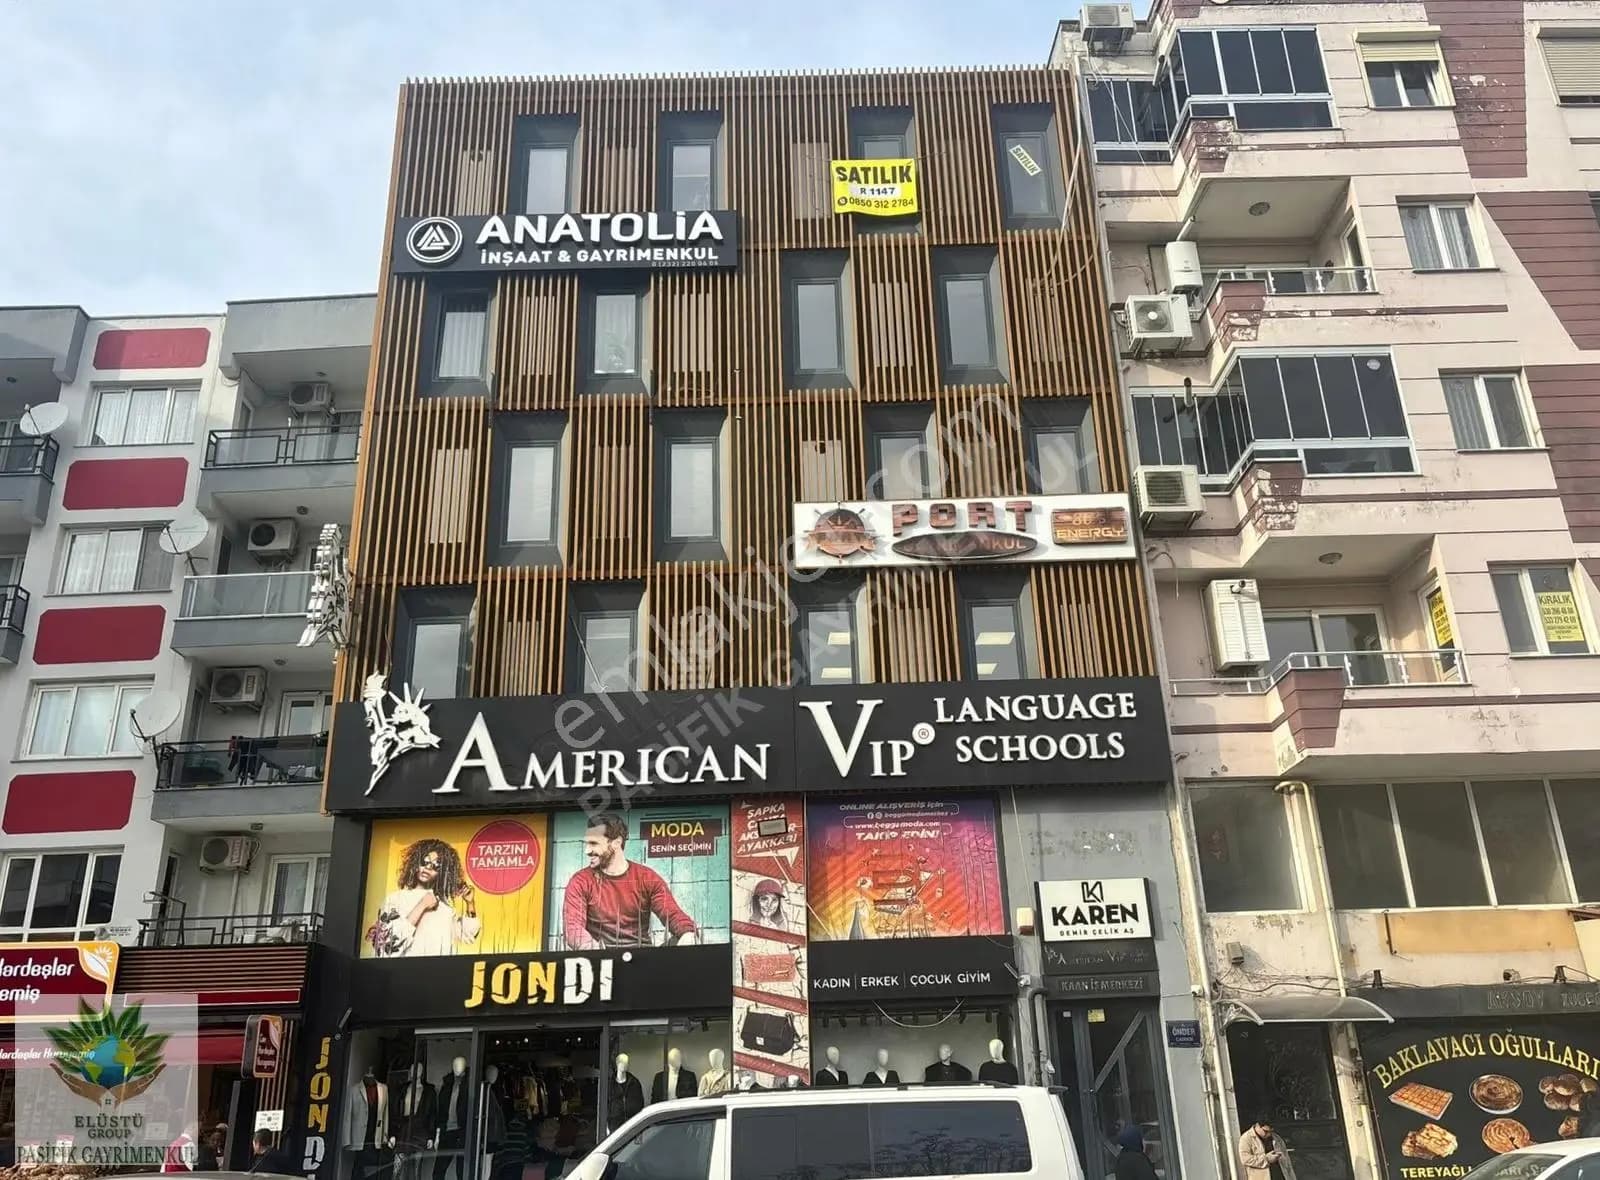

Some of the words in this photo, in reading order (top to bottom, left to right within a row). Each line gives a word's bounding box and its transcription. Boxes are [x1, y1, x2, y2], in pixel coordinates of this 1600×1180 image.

[1013, 147, 1037, 173] SATILIK
[835, 165, 912, 185] SATILIK
[869, 187, 896, 196] 1147
[849, 198, 872, 208] 0850
[874, 199, 889, 209] 312
[891, 198, 914, 208] 2784
[481, 249, 552, 267] İNŞAAT
[557, 250, 571, 263] &
[577, 247, 719, 264] GAYRİMENKUL
[892, 501, 1032, 536] PORT
[1056, 527, 1124, 538] ENERGY
[934, 692, 1137, 723] LANGUAGE
[432, 712, 770, 794] AMERICAN
[956, 732, 1125, 763] SCHOOLS
[650, 822, 705, 838] MODA
[738, 823, 796, 842] AKSR
[478, 843, 529, 856] TARZINI
[650, 844, 676, 853] SENİN
[678, 842, 712, 854] SEÇİMİN
[737, 833, 798, 854] AYAKKABI
[470, 856, 535, 869] TAMAMLA
[1052, 903, 1139, 926] KAREN
[1093, 927, 1119, 936] ÇELİK
[464, 956, 614, 1009] JONDI
[813, 978, 850, 989] KADIN
[861, 976, 899, 988] ERKEK
[910, 974, 952, 986] ÇOCUK
[957, 970, 991, 984] GİYİM
[1372, 1032, 1487, 1089] BAKLAVACI
[1489, 1026, 1600, 1081] OĞULLARI
